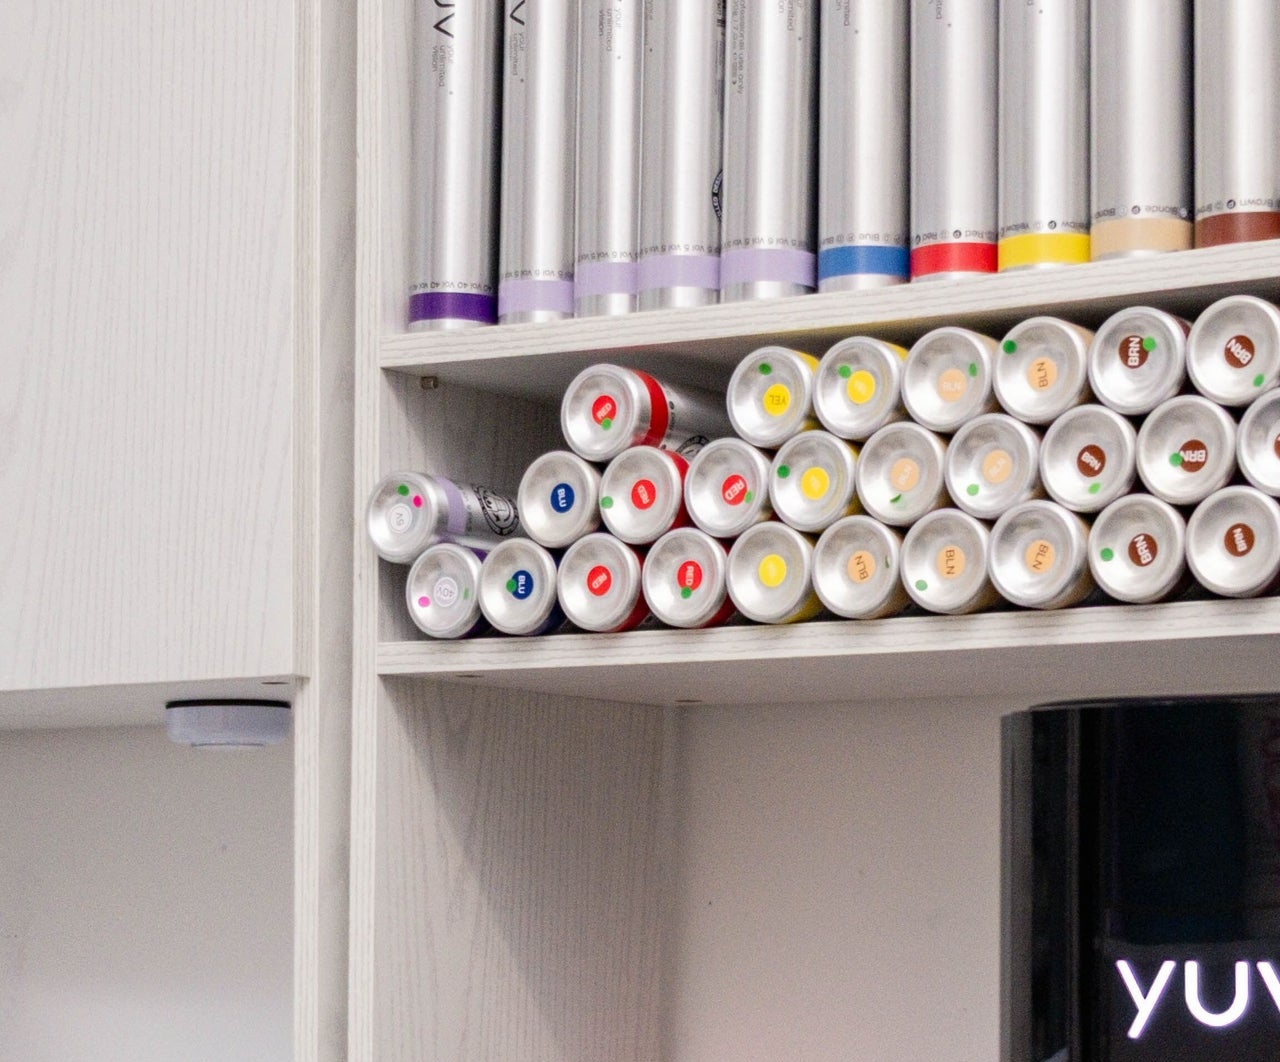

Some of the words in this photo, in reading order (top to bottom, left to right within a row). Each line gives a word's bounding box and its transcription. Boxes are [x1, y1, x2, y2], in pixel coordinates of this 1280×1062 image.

[1127, 337, 1141, 366] BRN
[1226, 338, 1252, 365] BRN
[1036, 362, 1049, 388] BLN
[769, 394, 787, 406] YEL
[596, 403, 613, 420] RED
[1080, 452, 1102, 471] BRN
[1180, 450, 1206, 462] BRN
[557, 487, 567, 508] BLU
[637, 485, 650, 505] RED
[724, 479, 746, 501] RED
[1134, 535, 1153, 564] BRN
[1232, 527, 1248, 553] BRN
[855, 555, 869, 580] BLN
[945, 549, 956, 575] BLN
[1032, 544, 1049, 570] BLN
[517, 575, 527, 594] BLU
[591, 572, 608, 589] RED
[686, 565, 695, 586] RED
